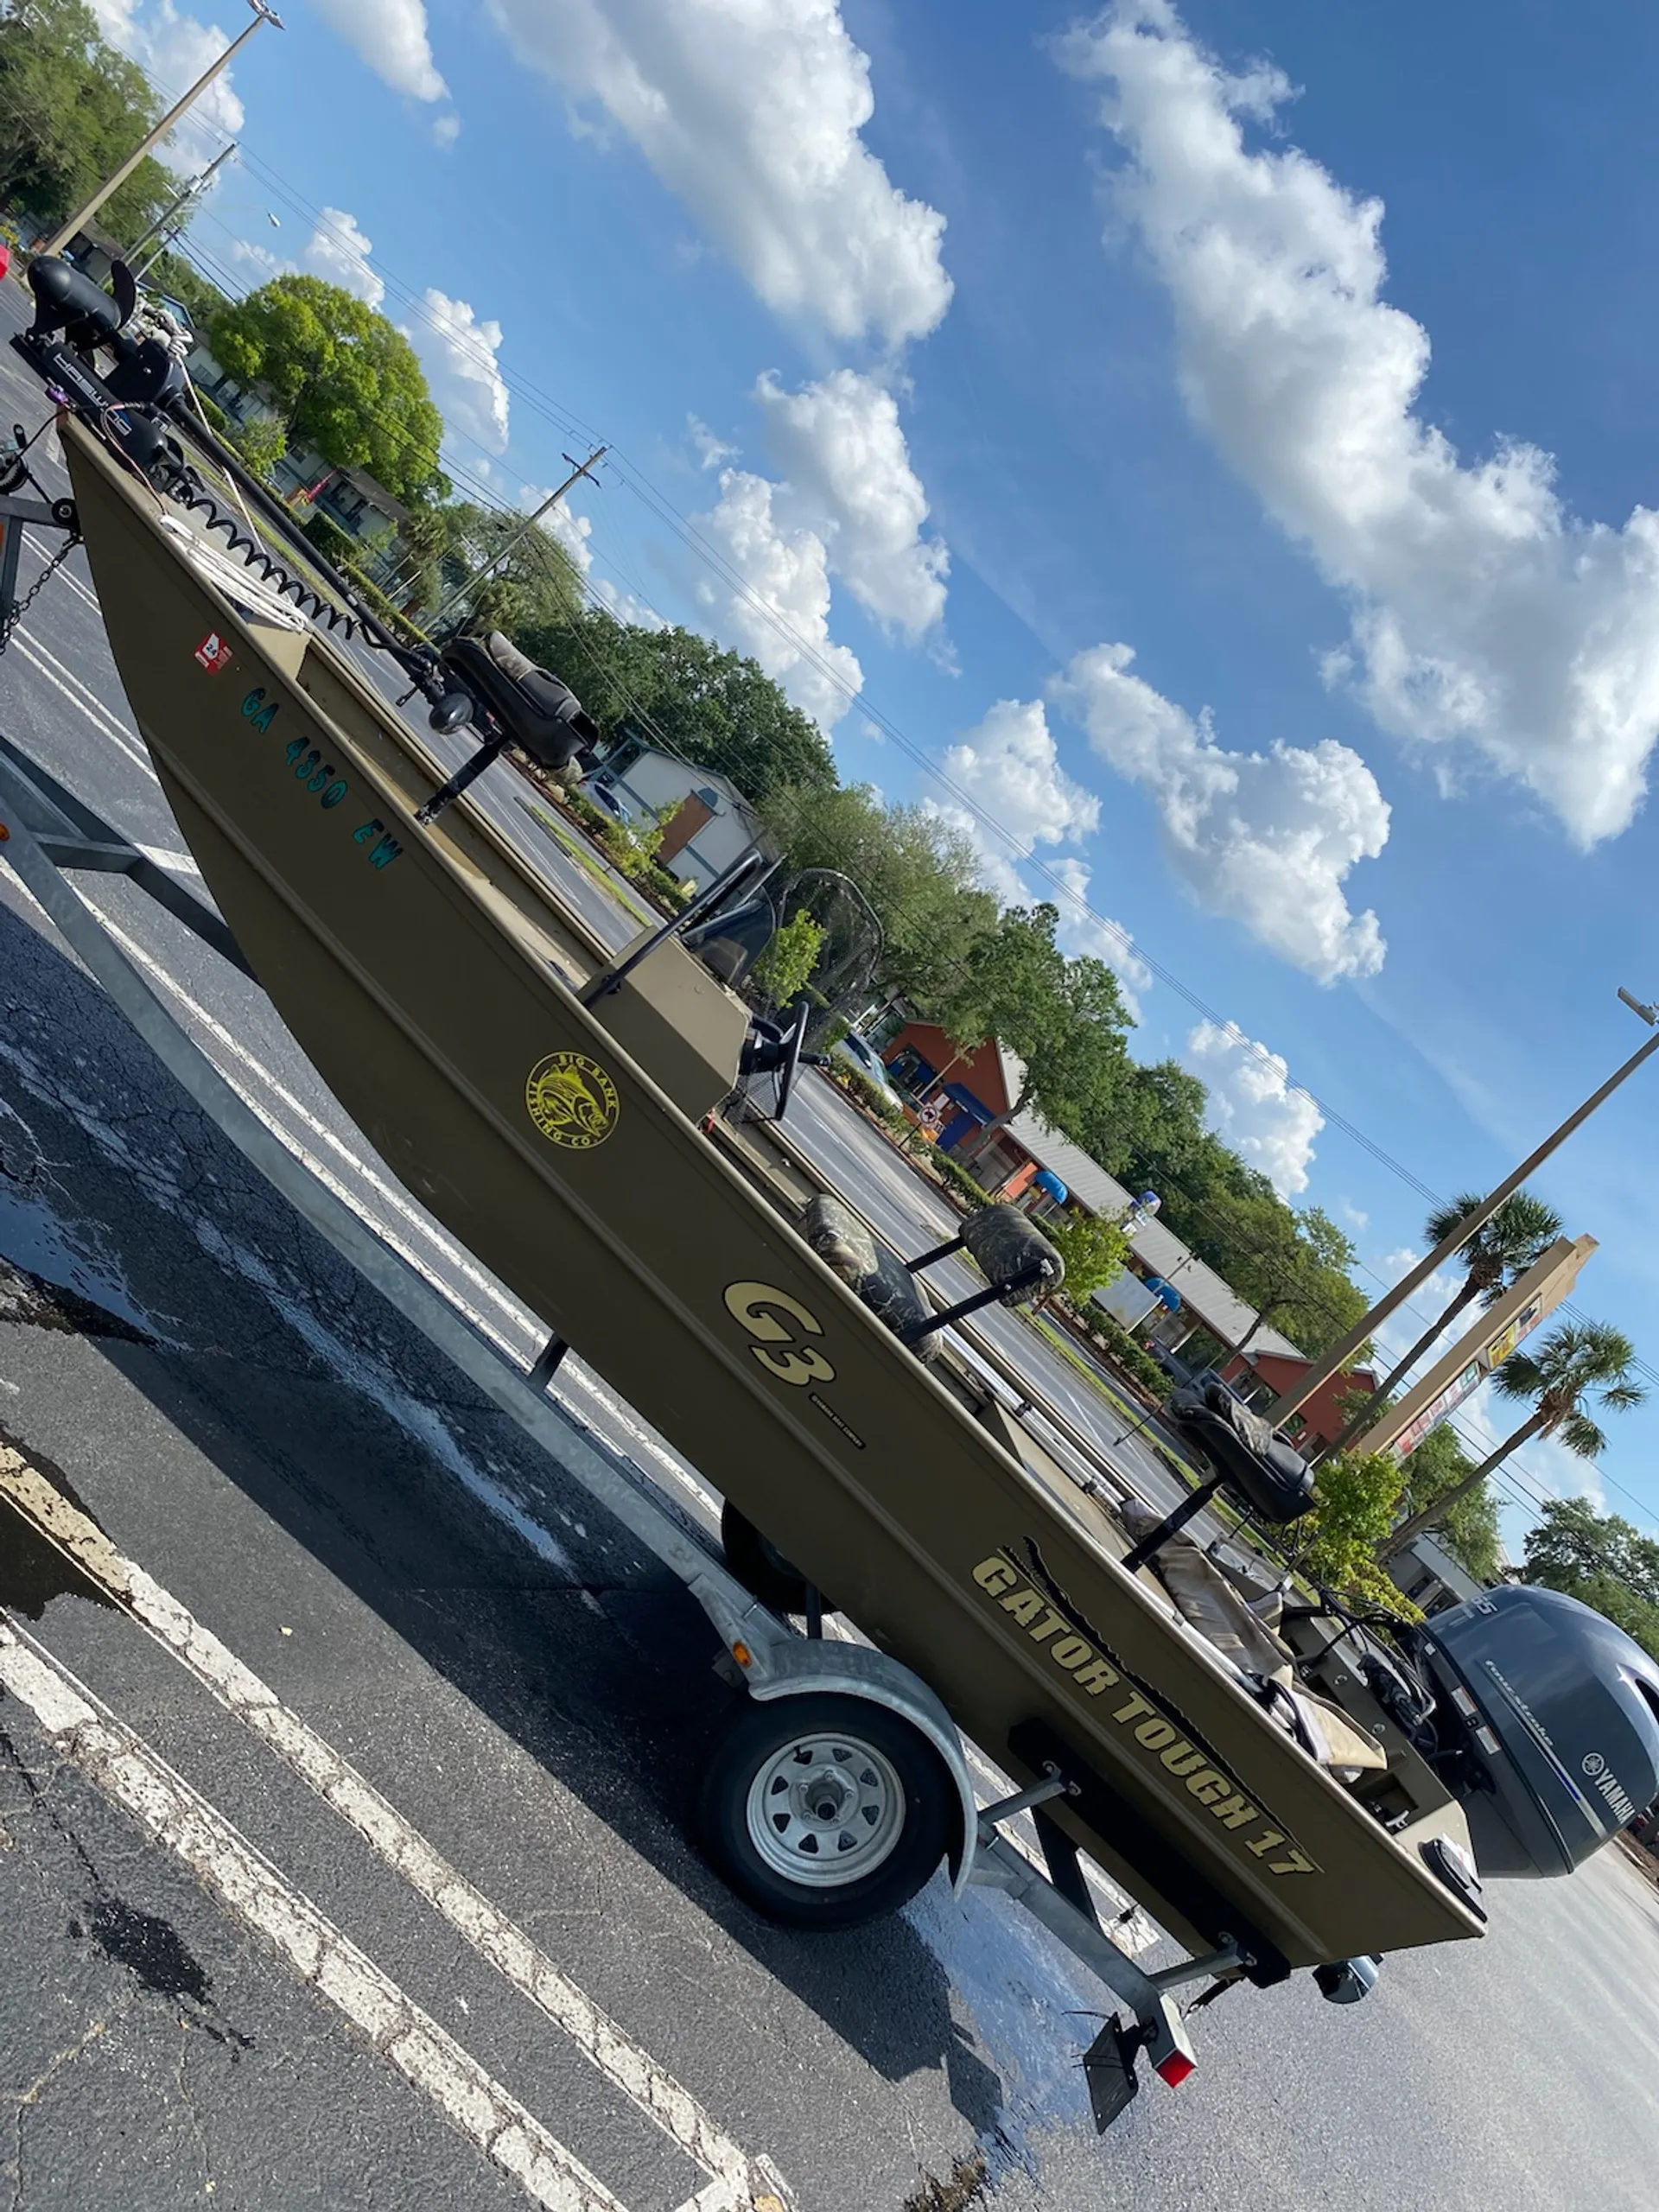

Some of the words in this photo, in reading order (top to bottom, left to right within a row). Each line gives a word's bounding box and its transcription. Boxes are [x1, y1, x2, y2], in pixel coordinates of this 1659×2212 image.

[241, 687, 279, 734] GA
[286, 736, 348, 809] 4350
[352, 818, 404, 870] EW
[528, 1081, 563, 1141] FISHING
[591, 1067, 617, 1108] BANK
[722, 1280, 836, 1387] G3
[971, 1555, 1120, 1698] GATOR
[1111, 1691, 1261, 1830] TOUGH
[1244, 1829, 1315, 1876] 17
[1593, 1770, 1636, 1824] YAMAHA
